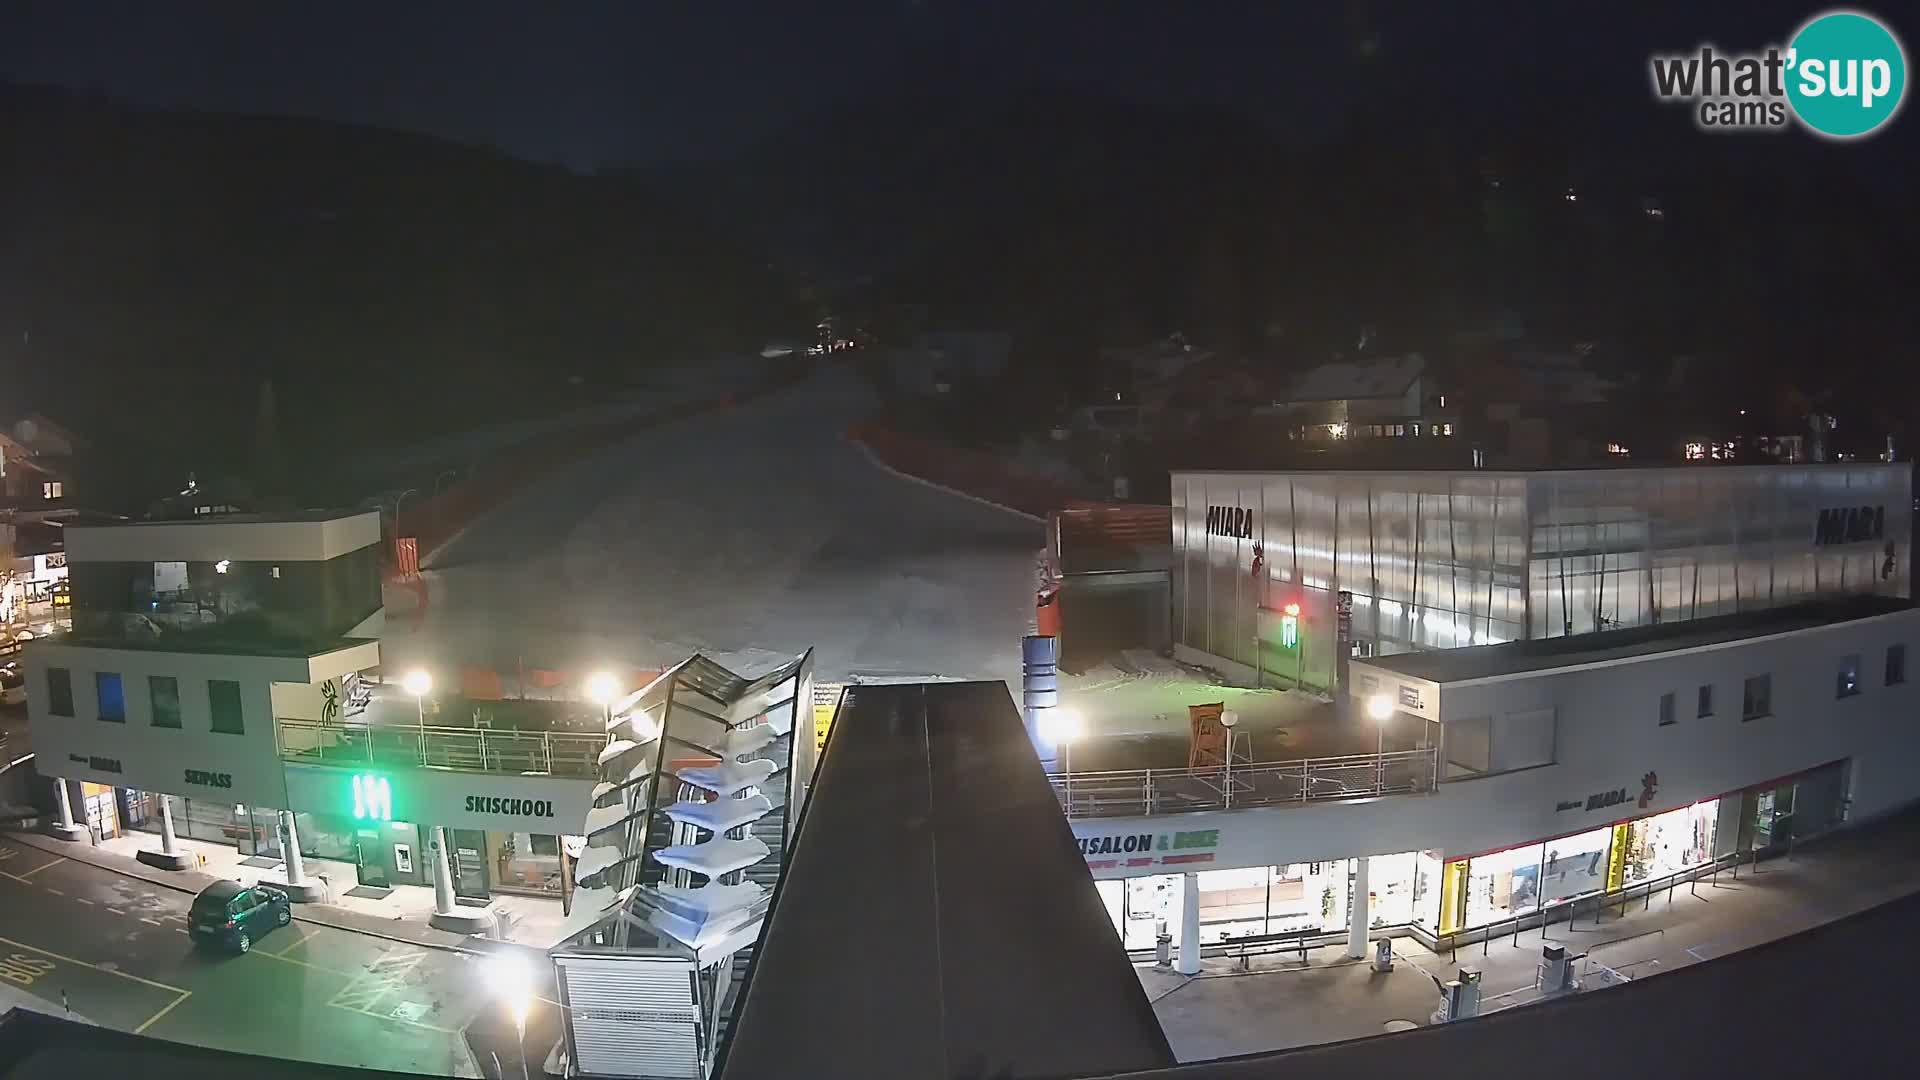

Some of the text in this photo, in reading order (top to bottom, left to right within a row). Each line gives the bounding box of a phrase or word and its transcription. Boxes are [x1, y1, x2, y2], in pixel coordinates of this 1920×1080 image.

[1206, 505, 1253, 539] MIARA
[465, 796, 555, 818] SKISCHOOL
[0, 953, 56, 985] BUS
